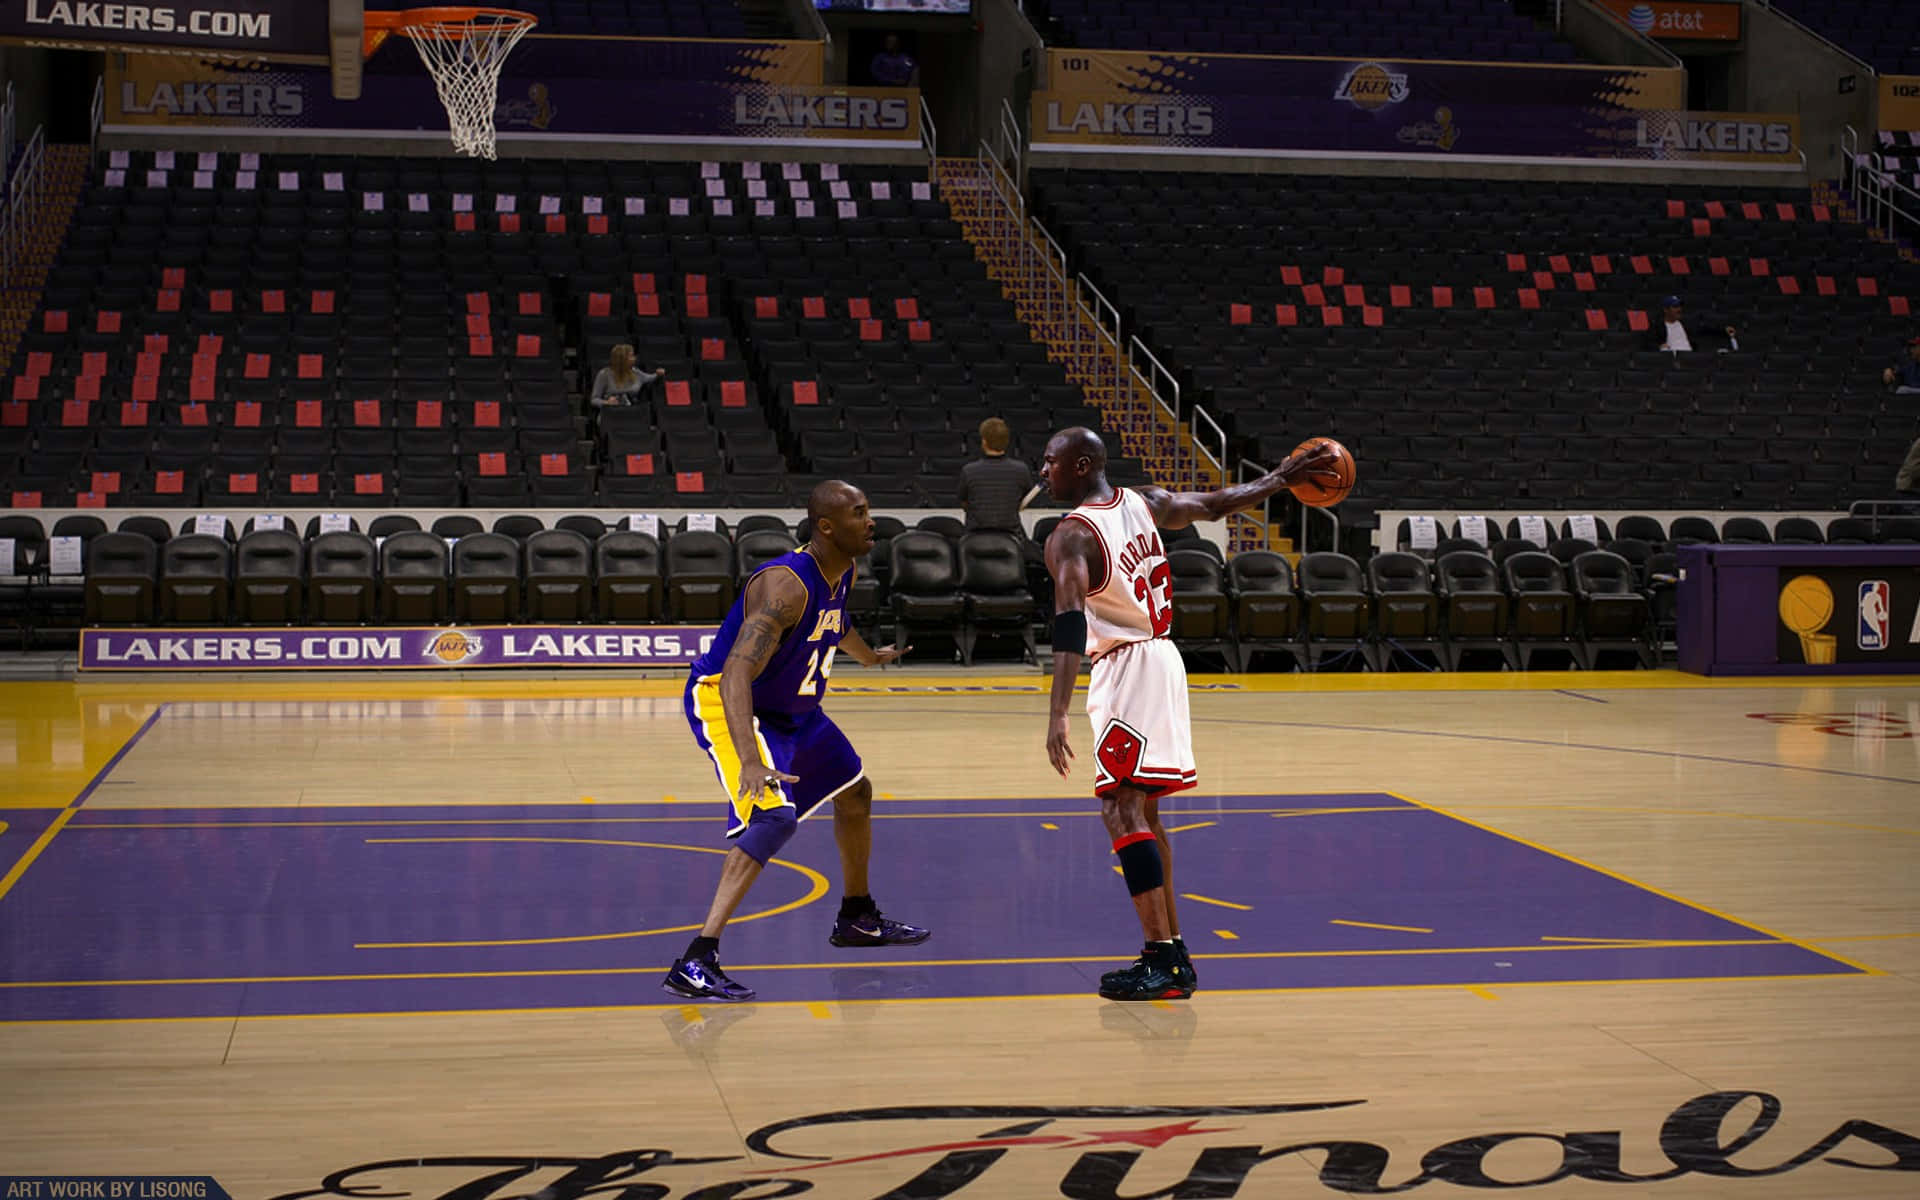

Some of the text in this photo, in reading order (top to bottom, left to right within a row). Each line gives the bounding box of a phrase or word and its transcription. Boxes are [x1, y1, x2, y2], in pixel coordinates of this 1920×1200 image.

[25, 0, 271, 38] LAKERS.COM
[1660, 9, 1705, 31] at&t
[1062, 58, 1090, 71] 101
[122, 81, 303, 116] LAKERS
[735, 95, 907, 129] LAKERS
[1047, 102, 1213, 136] LAKERS
[1636, 119, 1791, 153] LAKERS
[1118, 532, 1162, 583] JORDA
[1134, 561, 1173, 638] 23
[96, 637, 402, 661] LAKERS.COM
[502, 634, 717, 657] LAKERS.C
[797, 645, 838, 696] 24
[745, 1089, 1920, 1200] Finals
